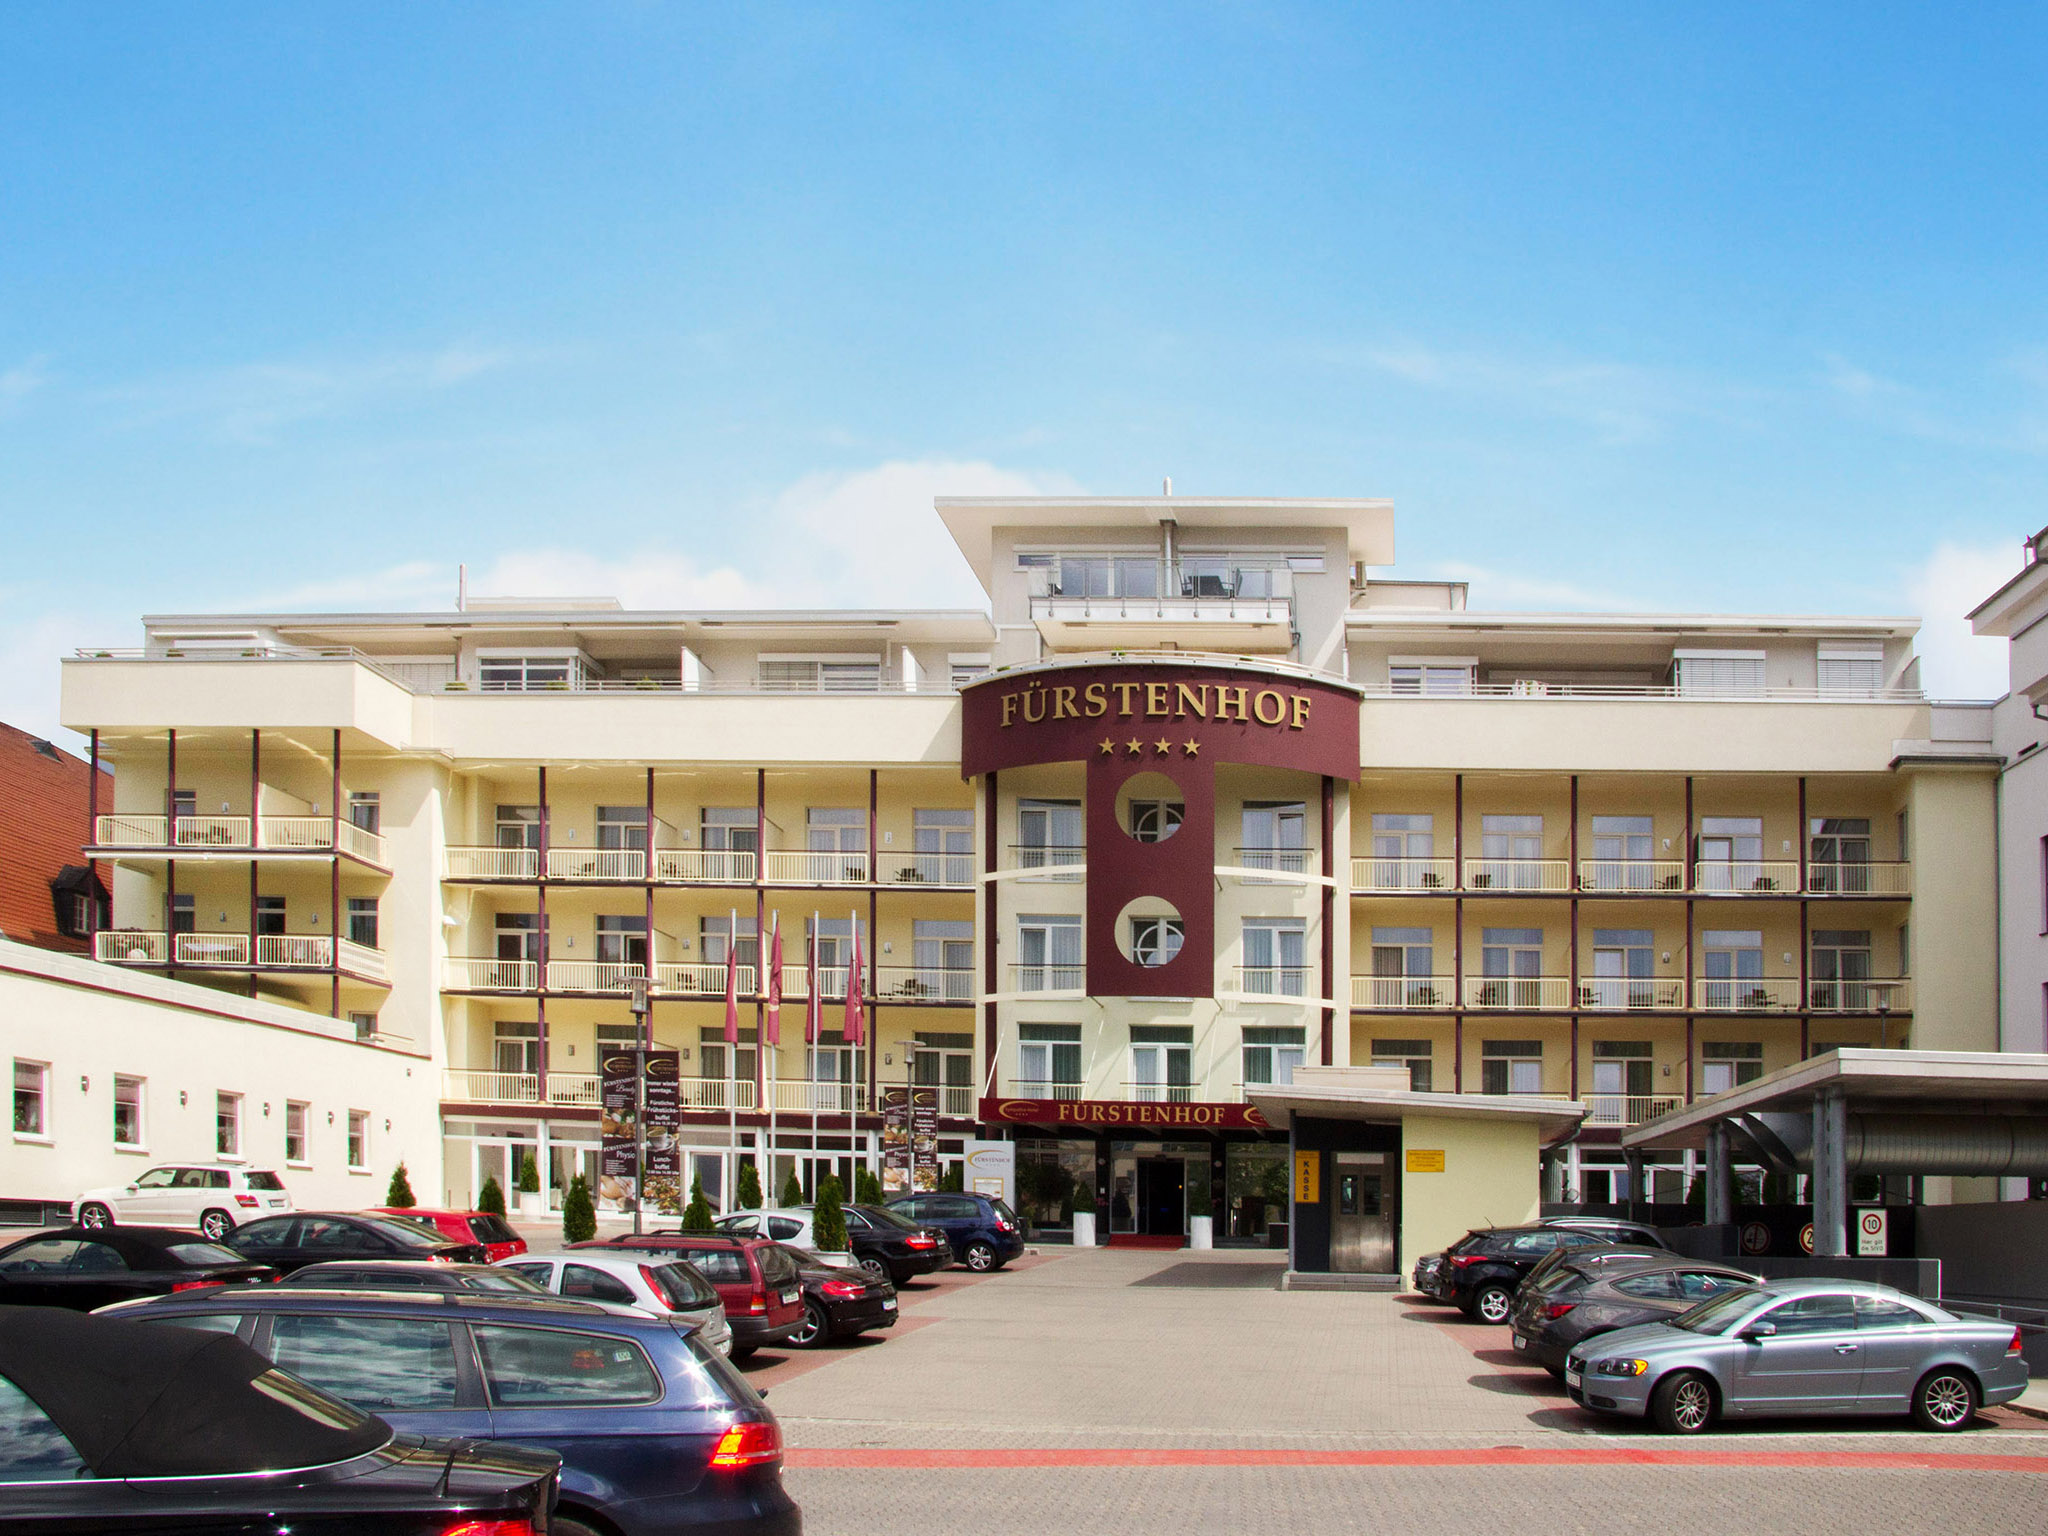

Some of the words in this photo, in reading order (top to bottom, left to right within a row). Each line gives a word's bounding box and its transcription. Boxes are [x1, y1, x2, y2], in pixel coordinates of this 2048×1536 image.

[1001, 681, 1311, 728] FÜRSTENHOF
[1058, 1101, 1225, 1124] FÜRSTENHOF
[616, 1150, 636, 1160] Physio
[1867, 1219, 1877, 1229] 10
